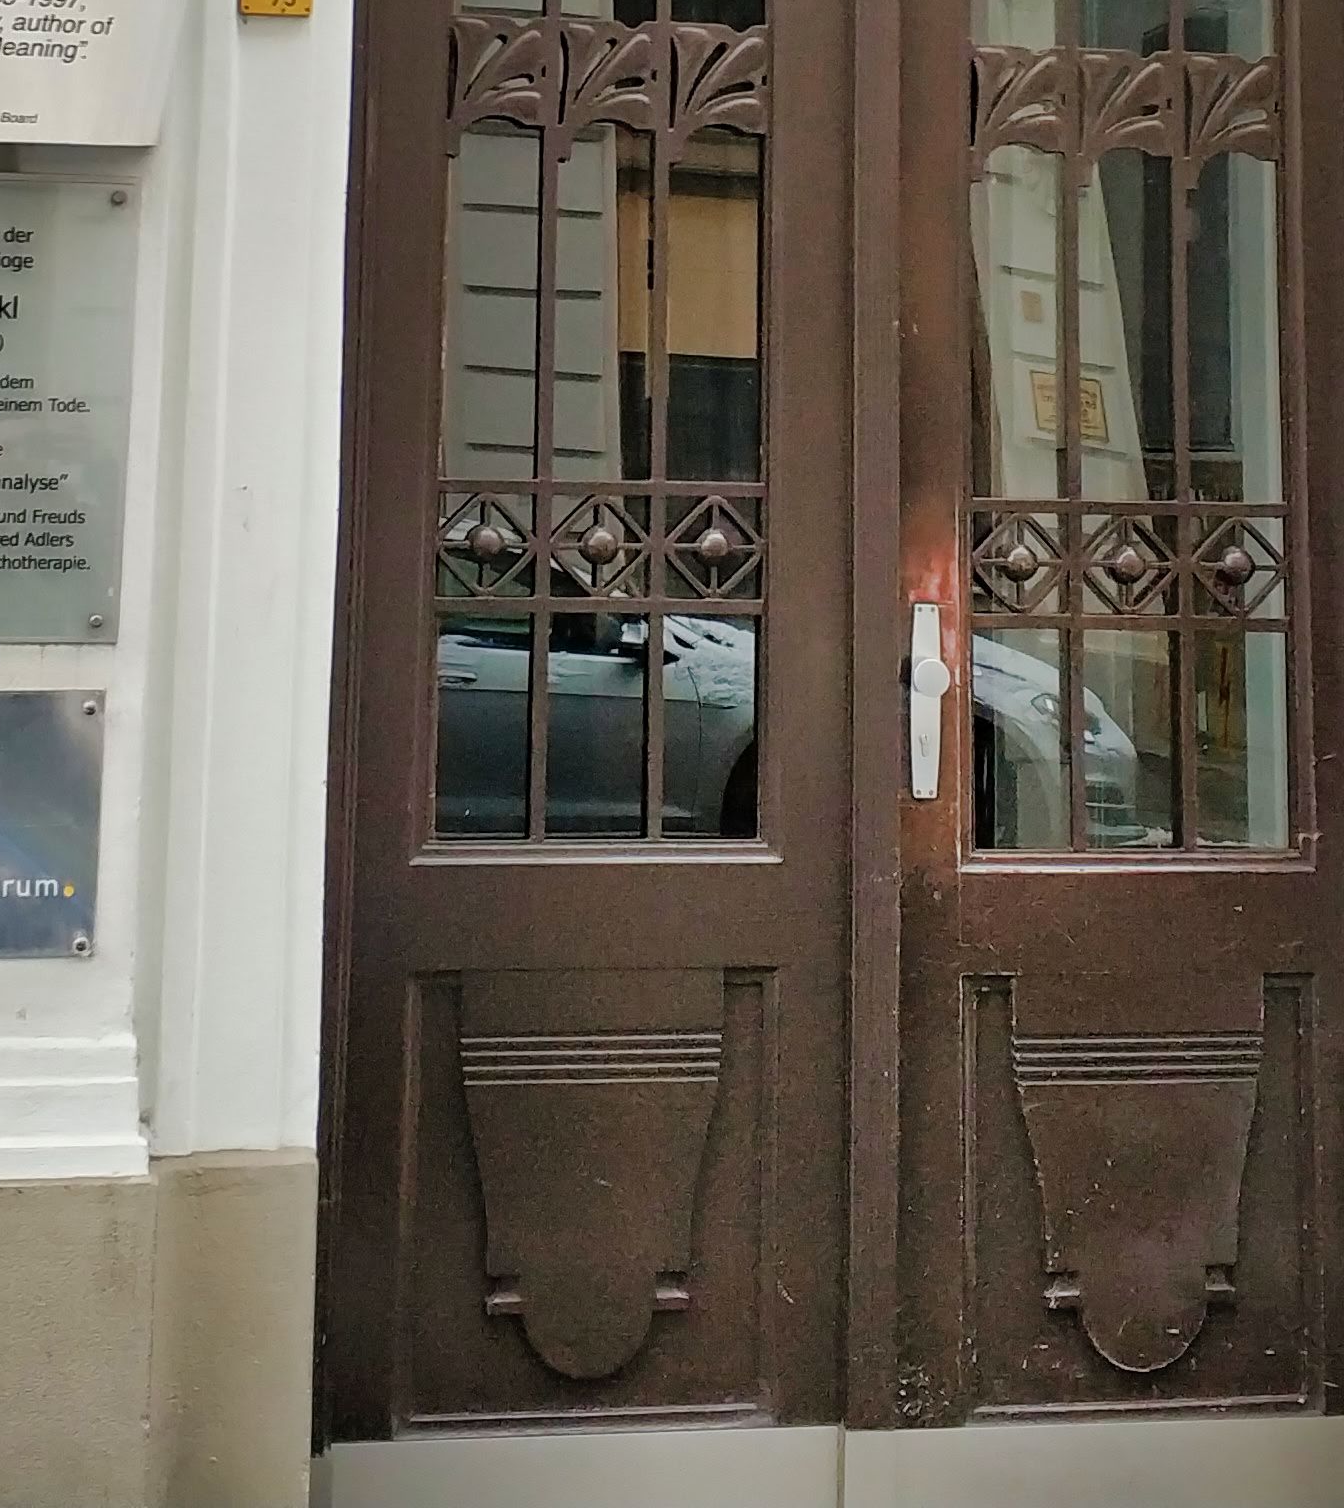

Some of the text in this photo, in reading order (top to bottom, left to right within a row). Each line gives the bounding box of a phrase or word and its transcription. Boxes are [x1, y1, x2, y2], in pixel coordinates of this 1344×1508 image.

[11, 14, 87, 34] author
[90, 17, 114, 35] of
[0, 112, 38, 124] Board
[3, 227, 34, 243] der
[48, 398, 90, 413] Tode.
[32, 509, 85, 524] Freuds
[24, 532, 74, 547] Adlers
